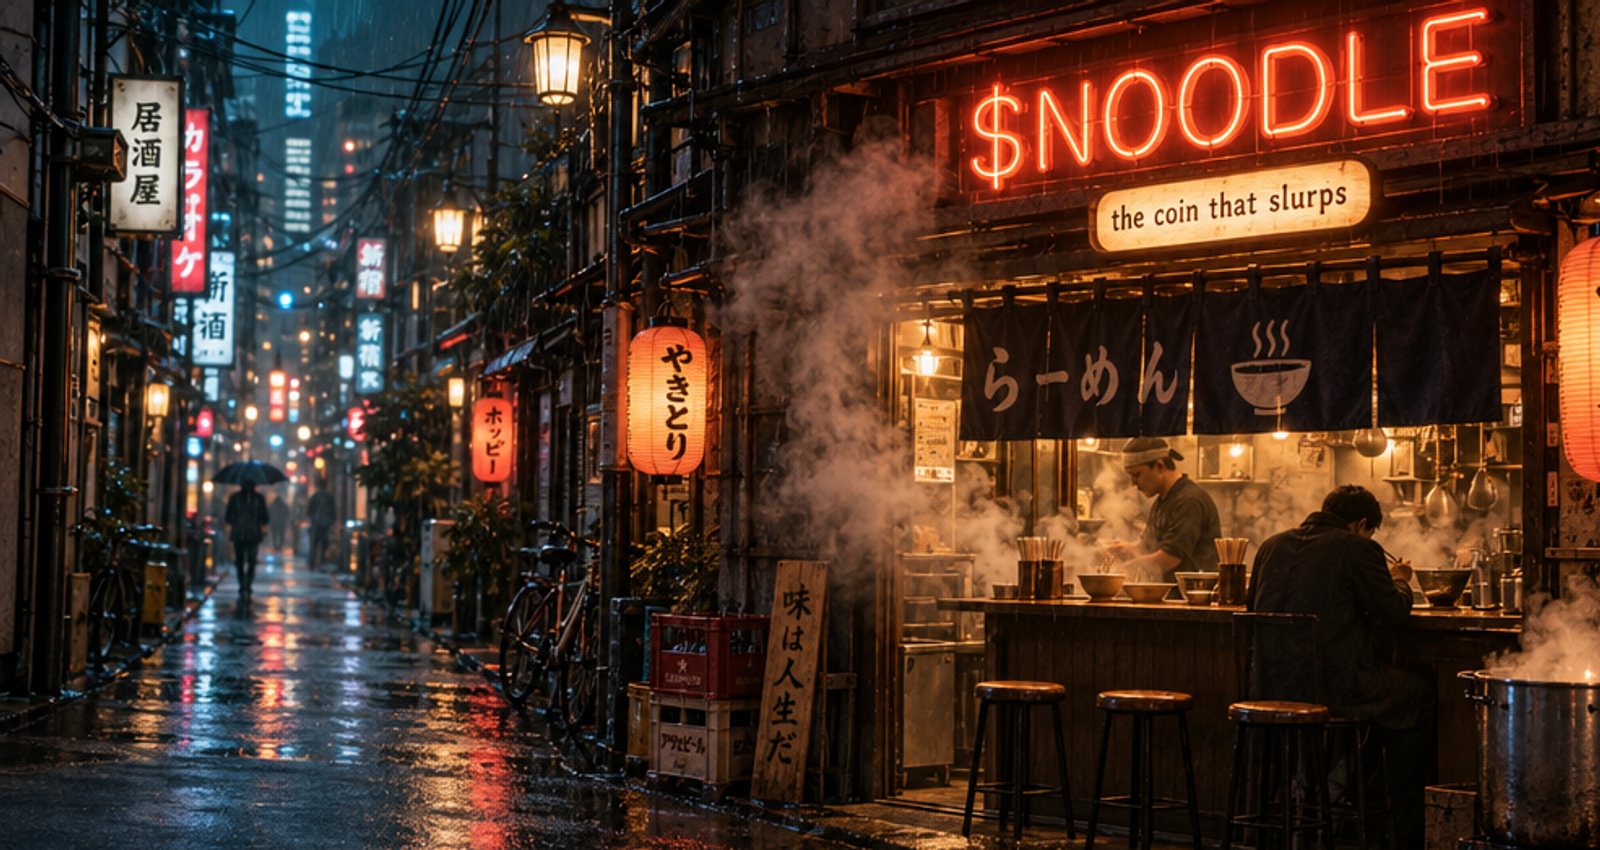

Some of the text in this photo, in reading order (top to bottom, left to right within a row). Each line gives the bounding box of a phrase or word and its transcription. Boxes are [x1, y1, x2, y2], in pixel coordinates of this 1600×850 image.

[130, 101, 163, 205] 居酒屋
[970, 6, 1492, 191] $NOODLE
[175, 122, 205, 278] カラオケ
[1111, 182, 1348, 233] the coin that slurps
[661, 344, 693, 461] やきとり
[983, 341, 1181, 413] らーめん
[485, 406, 506, 475] ホッピー
[767, 583, 812, 765] 味は人生だ
